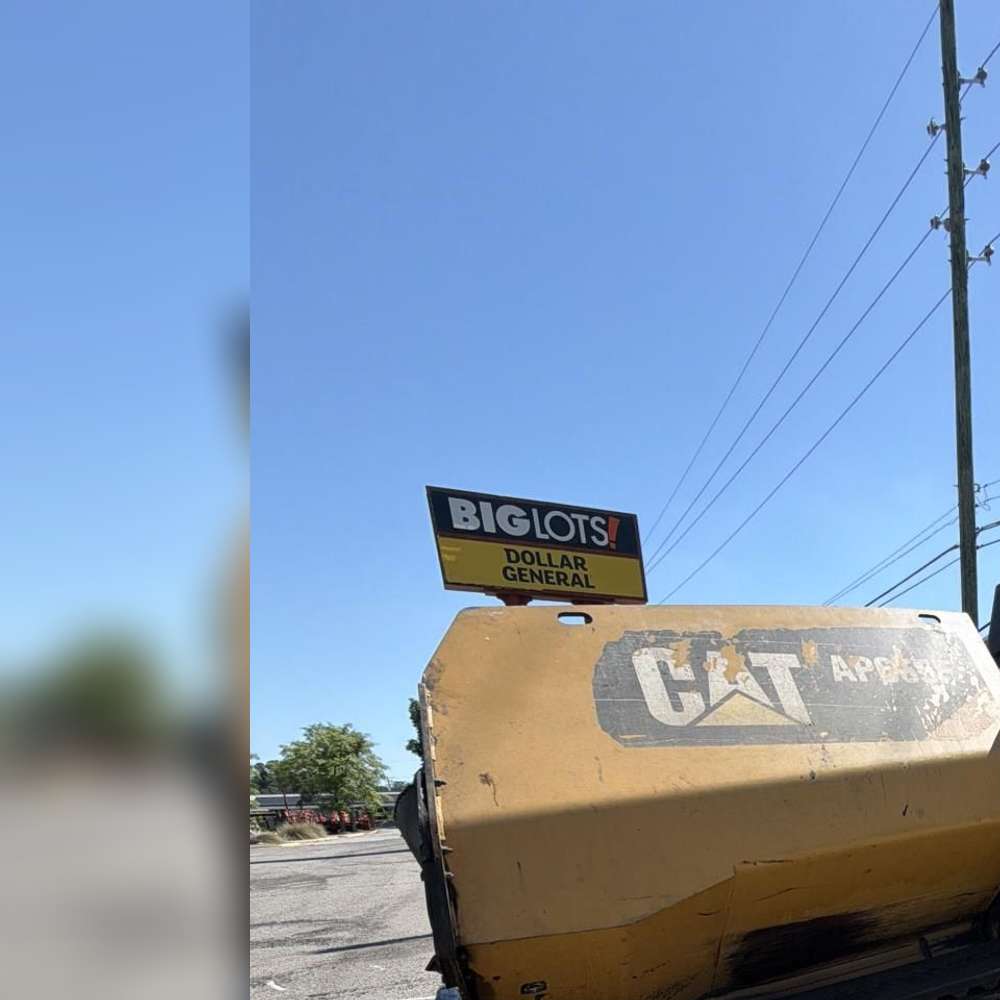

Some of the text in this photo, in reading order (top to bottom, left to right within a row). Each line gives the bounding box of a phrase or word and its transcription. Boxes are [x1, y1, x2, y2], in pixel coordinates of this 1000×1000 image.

[503, 547, 588, 572] DOLLAR
[502, 566, 596, 589] GENERAL
[630, 646, 811, 727] CAT
